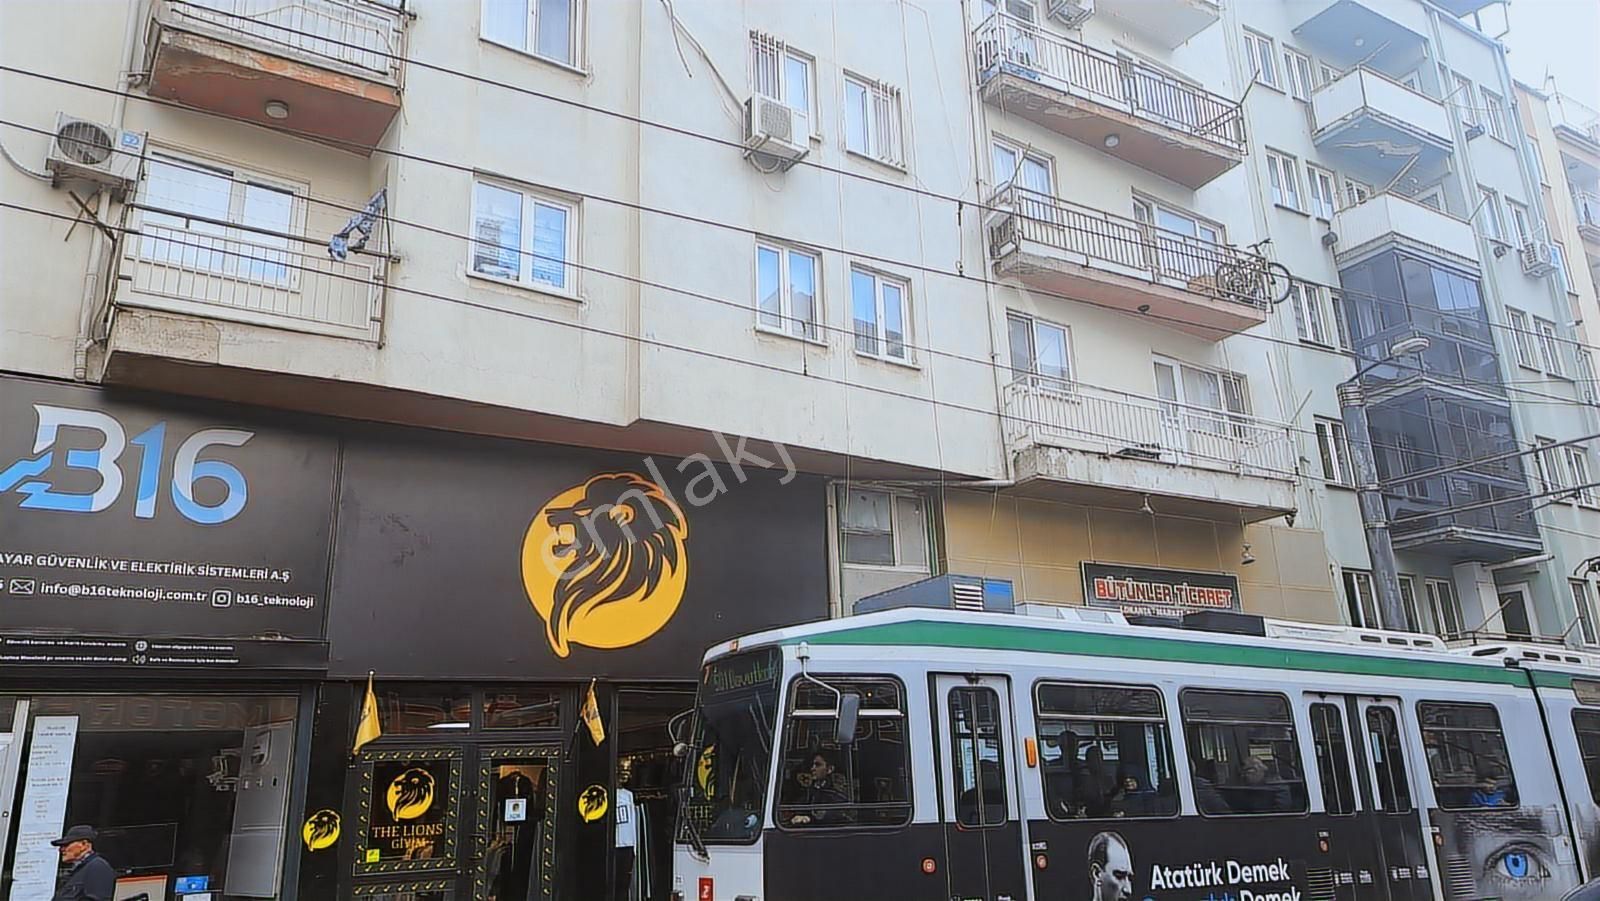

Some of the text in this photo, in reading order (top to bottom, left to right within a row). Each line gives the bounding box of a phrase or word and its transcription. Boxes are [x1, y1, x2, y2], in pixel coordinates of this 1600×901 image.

[18, 403, 256, 525] B16
[36, 553, 107, 570] GÜVENLİK
[110, 560, 128, 571] VE
[130, 561, 195, 576] ELEKTİRİK
[197, 565, 268, 580] SİSTEMLERİ
[41, 582, 207, 602] info@b16teknoloji.com.tr
[236, 593, 314, 609] b16_teknoloji
[1094, 576, 1232, 608] BÜTÜNLER TİCARET
[372, 824, 443, 838] THE LIONS
[1151, 857, 1290, 890] Atatürk Demek
